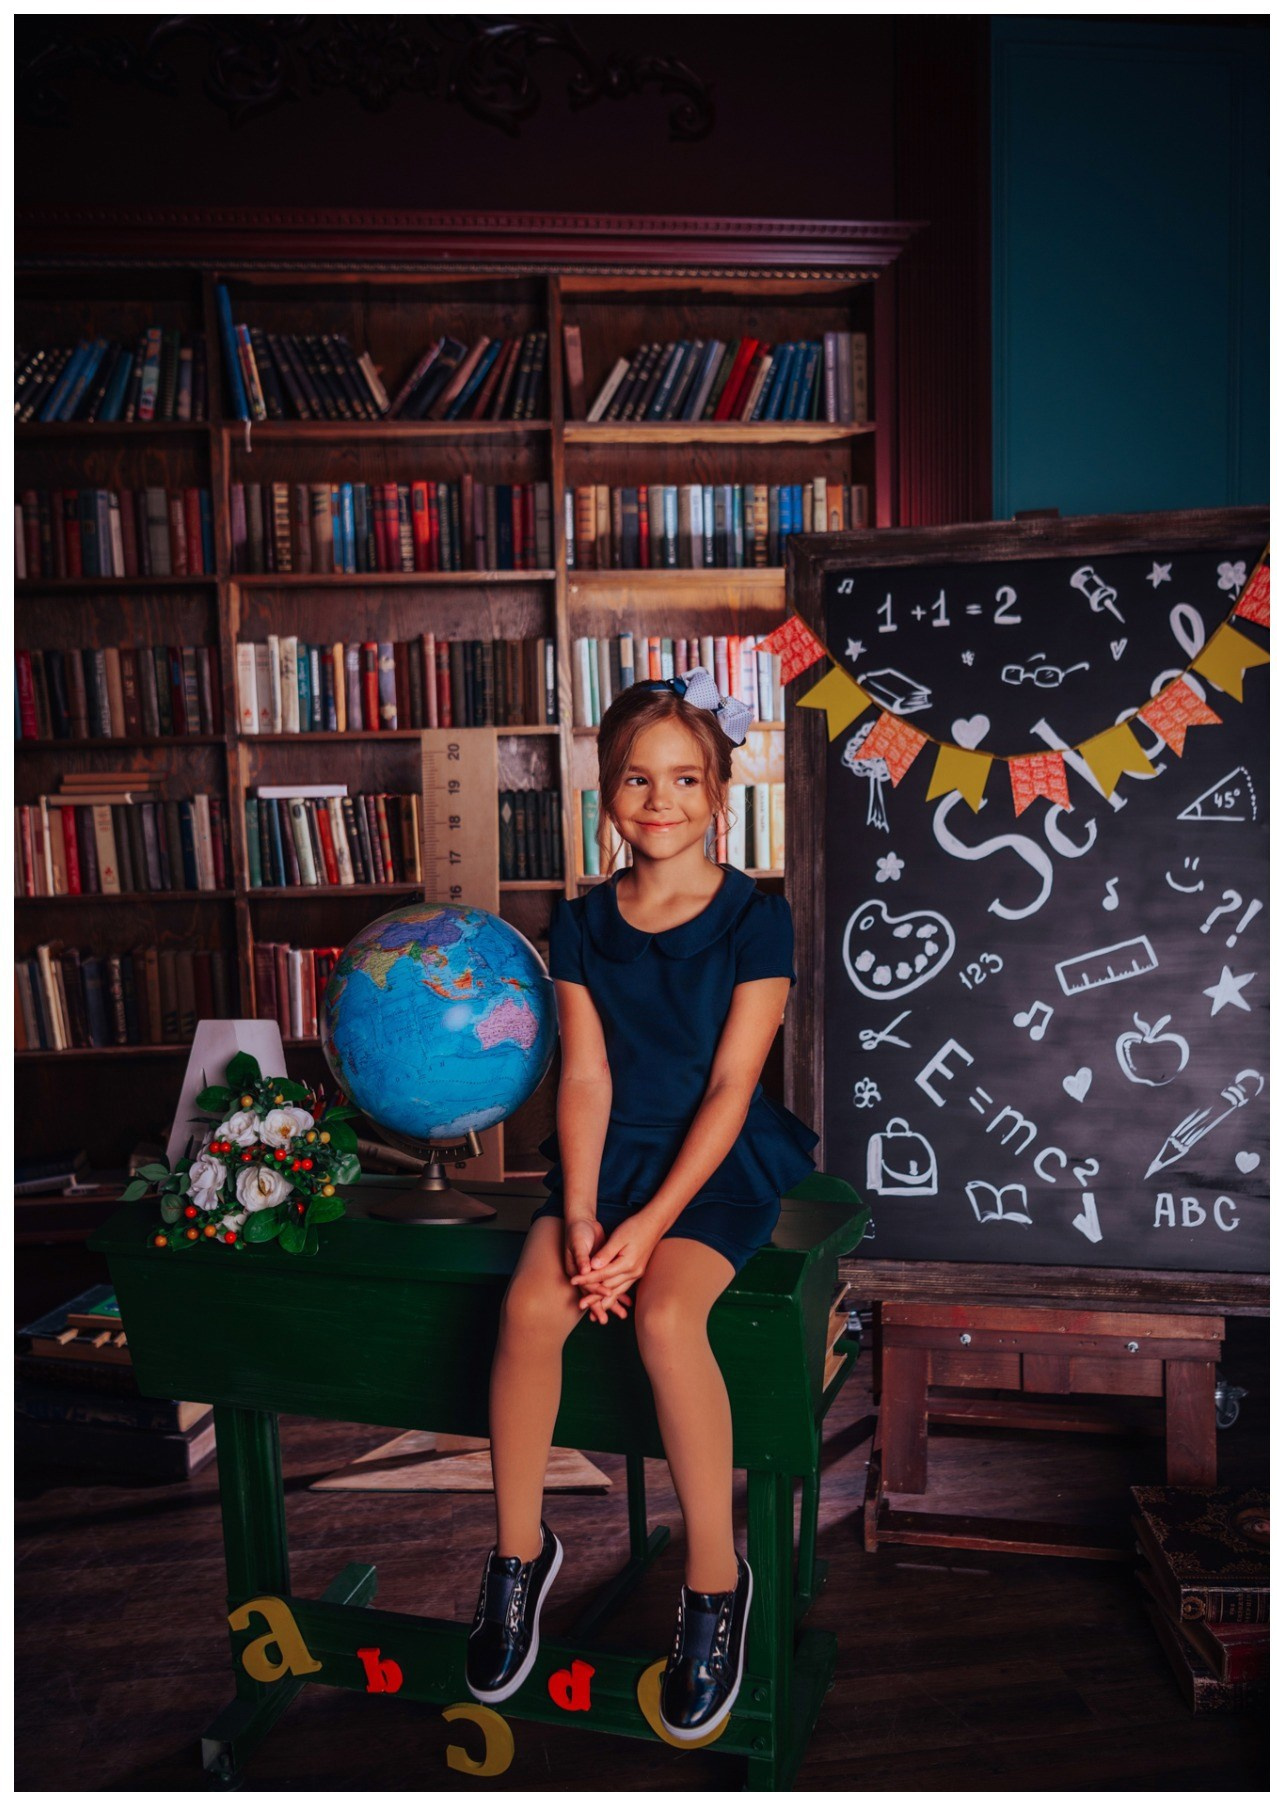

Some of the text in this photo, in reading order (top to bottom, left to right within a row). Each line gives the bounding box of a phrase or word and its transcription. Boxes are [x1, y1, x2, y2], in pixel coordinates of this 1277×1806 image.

[447, 742, 461, 761] 20
[447, 779, 461, 795] 19
[448, 814, 462, 830] 18
[449, 850, 462, 866] 17
[449, 884, 462, 900] 16
[957, 951, 1004, 990] 123
[227, 1596, 323, 1683] a
[356, 1646, 404, 1694] b
